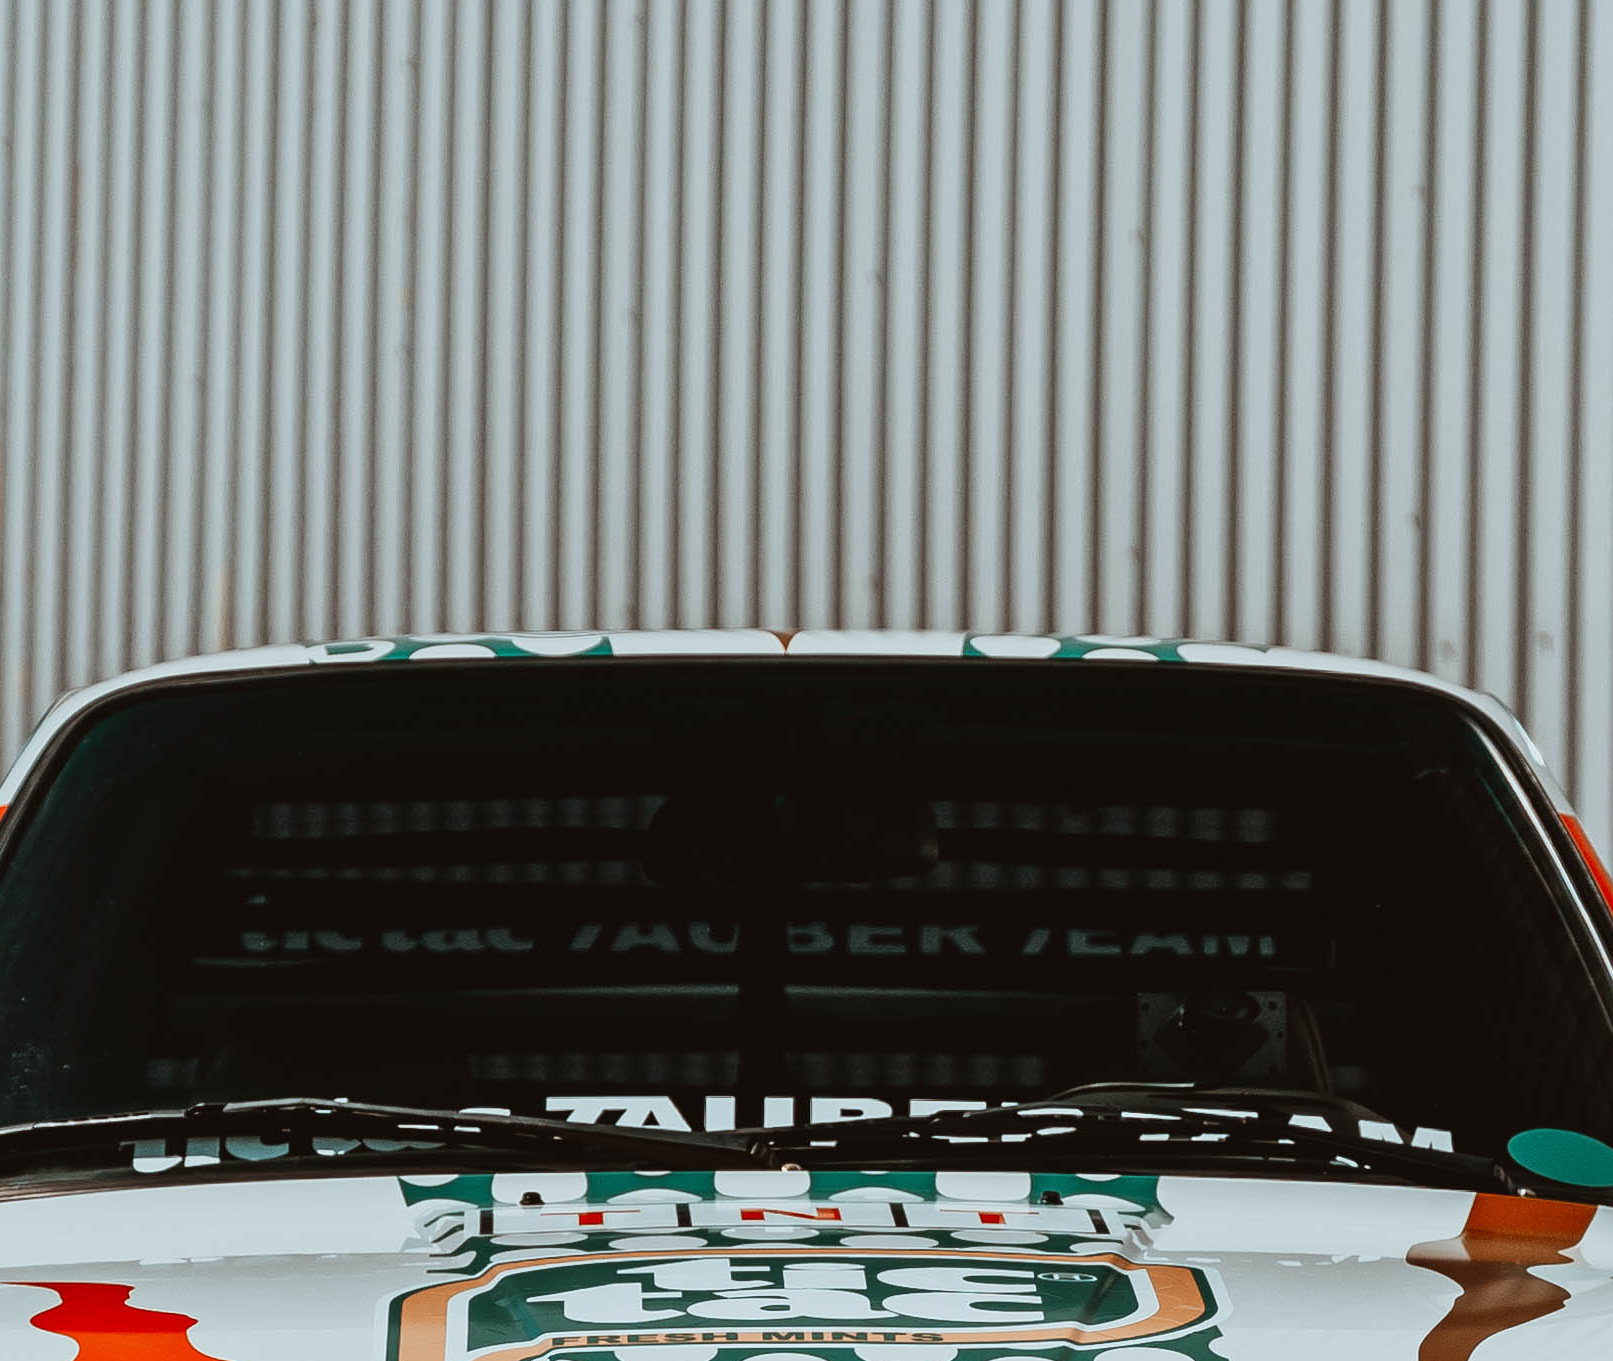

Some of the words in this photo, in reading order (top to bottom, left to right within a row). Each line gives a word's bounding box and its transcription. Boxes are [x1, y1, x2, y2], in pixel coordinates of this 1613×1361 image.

[545, 1096, 1083, 1147] TAUB
[616, 1258, 1038, 1292] tic
[526, 1282, 1045, 1324] tac
[552, 1333, 739, 1345] FRESH
[762, 1331, 944, 1342] MINTS
